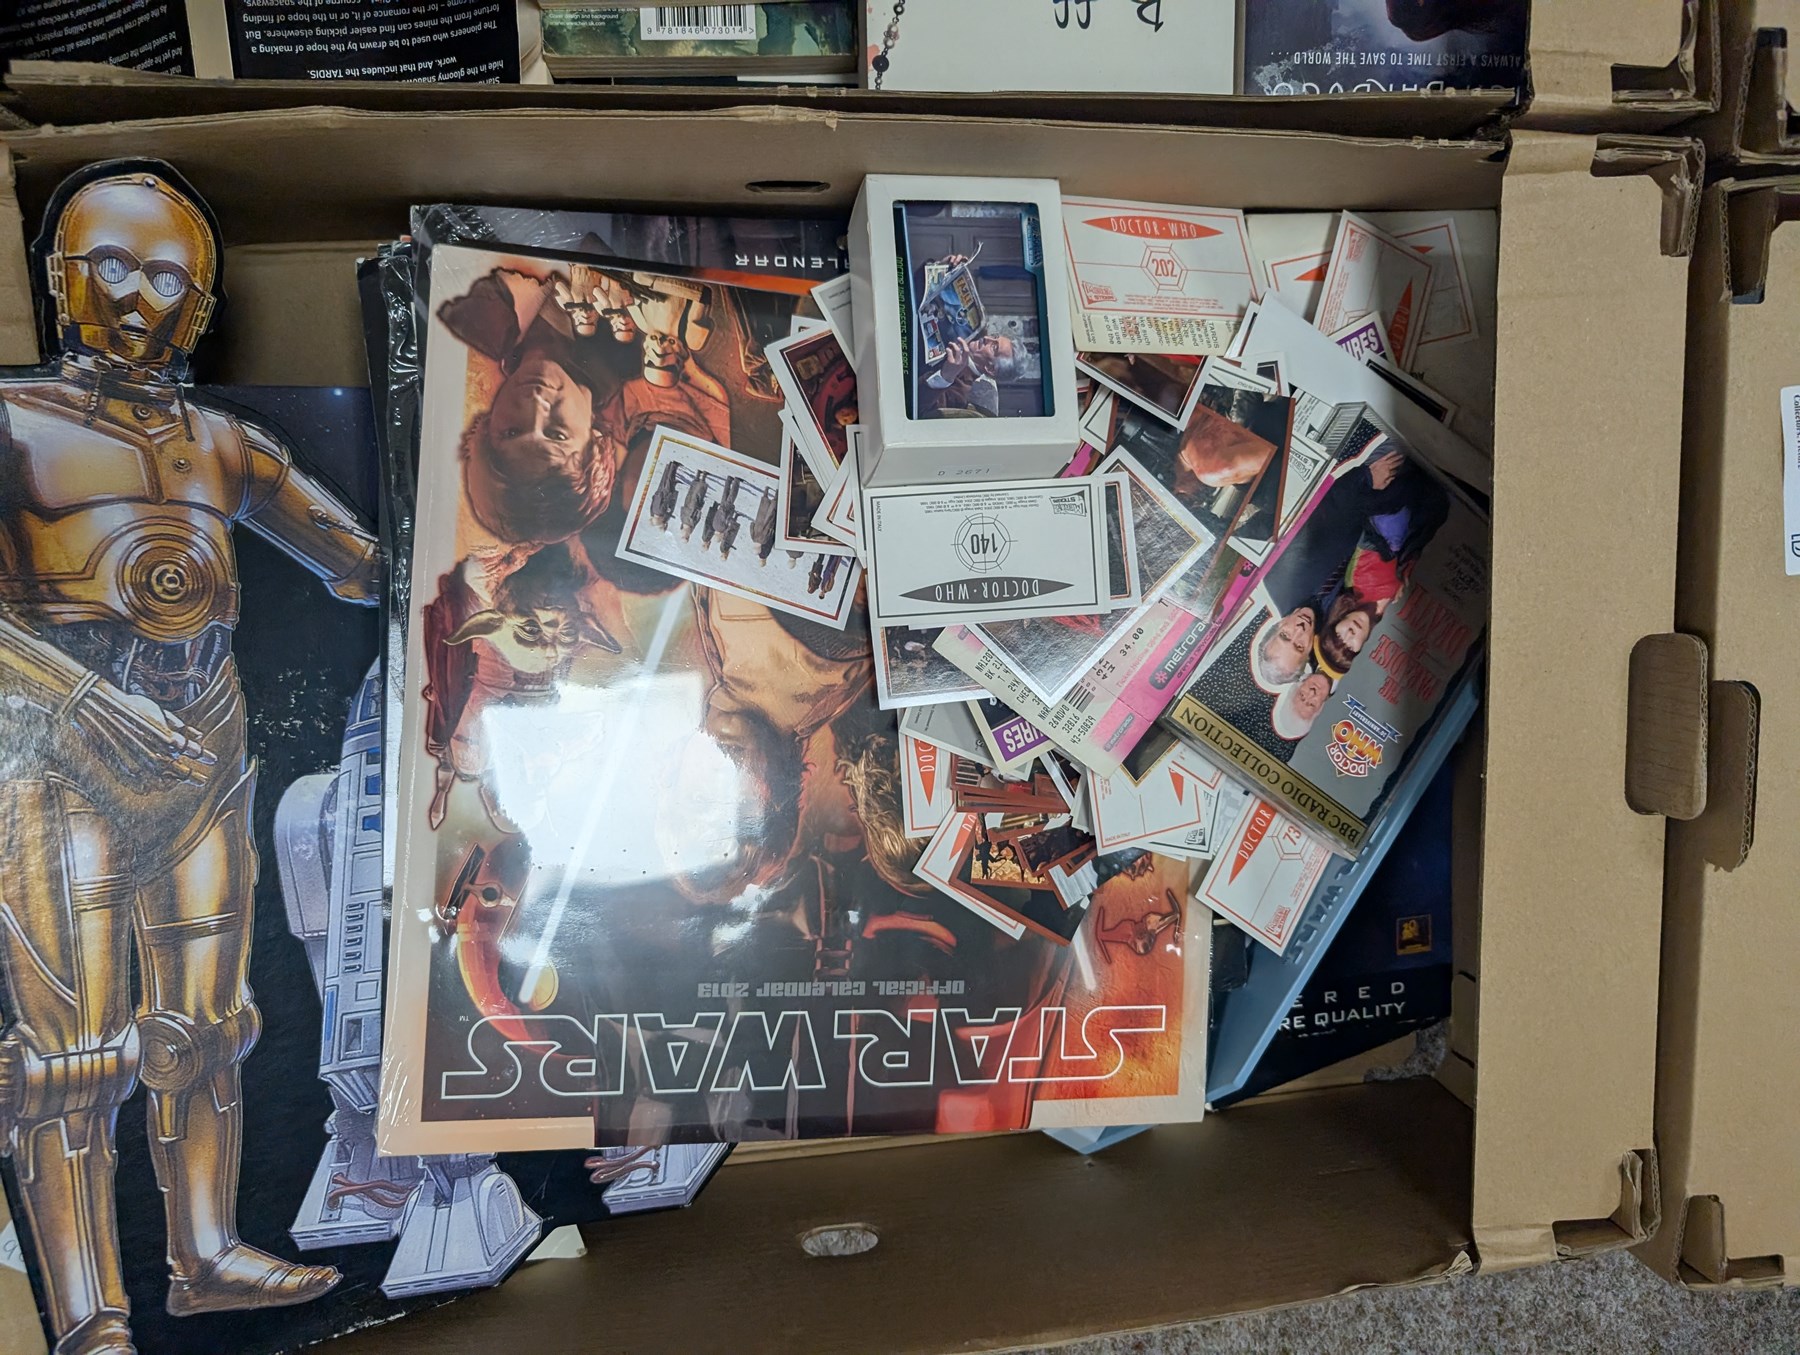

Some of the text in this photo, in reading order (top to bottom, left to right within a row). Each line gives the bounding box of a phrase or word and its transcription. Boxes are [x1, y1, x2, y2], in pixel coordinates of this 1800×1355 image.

[373, 7, 411, 18] romance
[412, 5, 426, 13] the
[427, 2, 439, 12] for
[243, 13, 274, 24] finding
[245, 3, 500, 40] fortune from the mines can find easier picking elsewhere. But
[277, 14, 285, 23] of
[287, 12, 311, 23] hope
[312, 13, 327, 22] the
[329, 13, 338, 21] in
[351, 11, 361, 20] it,
[363, 11, 372, 20] of
[450, 22, 482, 37] pioneers
[483, 20, 498, 30] The
[661, 27, 700, 35] 781846
[704, 27, 744, 35] 073014
[152, 34, 169, 46] saved
[411, 35, 431, 47] used
[432, 31, 449, 42] who
[259, 43, 293, 55] making
[306, 42, 329, 53] hope
[330, 43, 345, 53] the
[347, 41, 358, 51] by
[359, 41, 387, 50] drawn
[389, 40, 400, 49] be
[401, 39, 410, 47] to
[295, 45, 304, 54] of
[1294, 51, 1332, 65] WORLD
[1335, 52, 1356, 65] THE
[1360, 53, 1386, 66] SAVE
[1390, 53, 1403, 66] TO
[1407, 53, 1433, 66] TIME
[1436, 54, 1467, 66] FIRST
[307, 56, 457, 79] work. And that includes the TARDIS.
[480, 64, 488, 73] in
[488, 59, 504, 70] hide
[438, 67, 465, 82] gloomy
[467, 66, 479, 76] the
[1110, 217, 1198, 238] DOCTOR WHO
[735, 254, 850, 269] LENDAR
[1152, 258, 1178, 278] 202
[1209, 321, 1220, 349] TARDIS
[971, 533, 998, 555] 140
[935, 580, 1040, 601] DOCTOR WHO
[1118, 626, 1145, 657] 34.00
[1162, 619, 1208, 674] metrora
[1333, 719, 1383, 768] WHO
[1328, 743, 1368, 776] DOCTOR
[1179, 705, 1361, 846] BBC RADIO COLLECTION
[1238, 808, 1272, 860] DOCTOR
[1282, 824, 1302, 847] 73
[697, 979, 966, 999] OFFICIAL CALENDAR 2013
[1314, 1001, 1406, 1028] QUALITY
[441, 1004, 1168, 1099] STAR WARS
